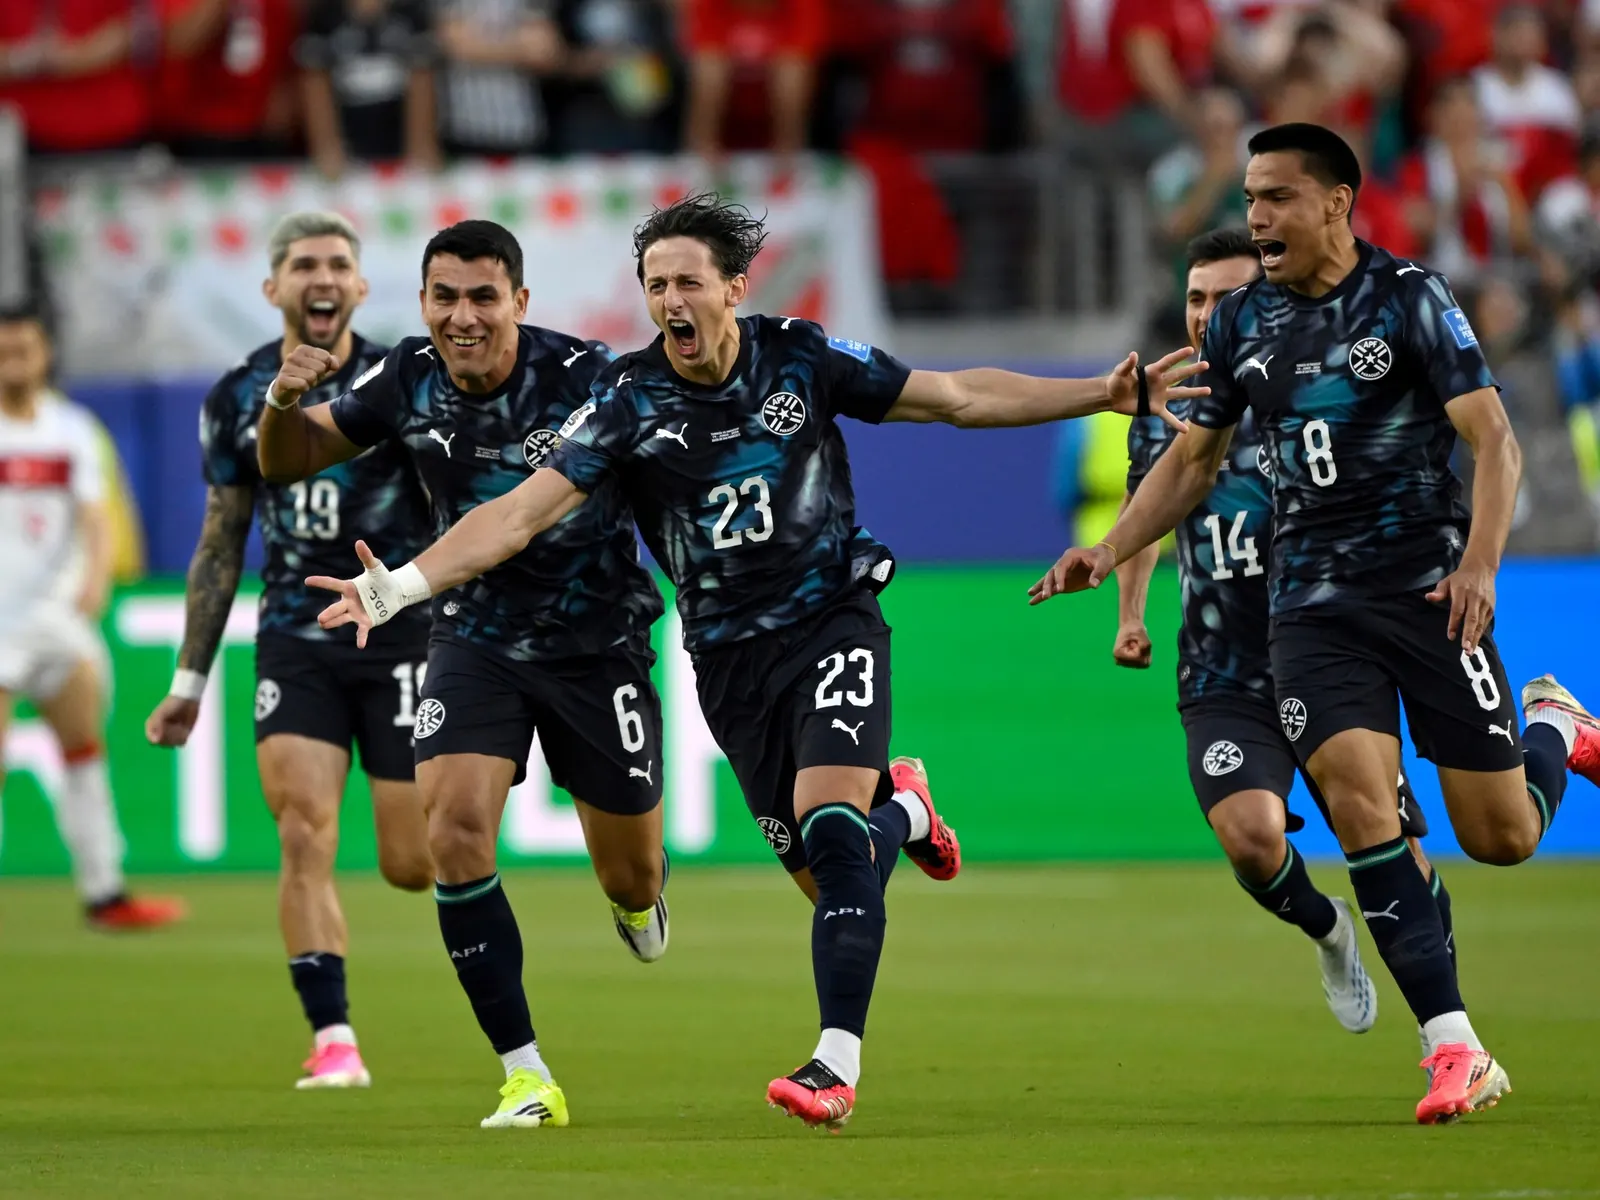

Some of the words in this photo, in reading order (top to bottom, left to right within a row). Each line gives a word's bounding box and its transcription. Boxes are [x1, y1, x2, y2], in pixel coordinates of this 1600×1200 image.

[772, 395, 786, 406] APF
[1303, 419, 1337, 487] 8
[289, 478, 340, 540] 19
[708, 474, 774, 550] 23
[1203, 510, 1264, 580] 14
[815, 648, 874, 710] 23
[1460, 645, 1500, 711] 8
[612, 683, 645, 753] 6
[824, 907, 866, 920] APF
[451, 942, 488, 959] APF
